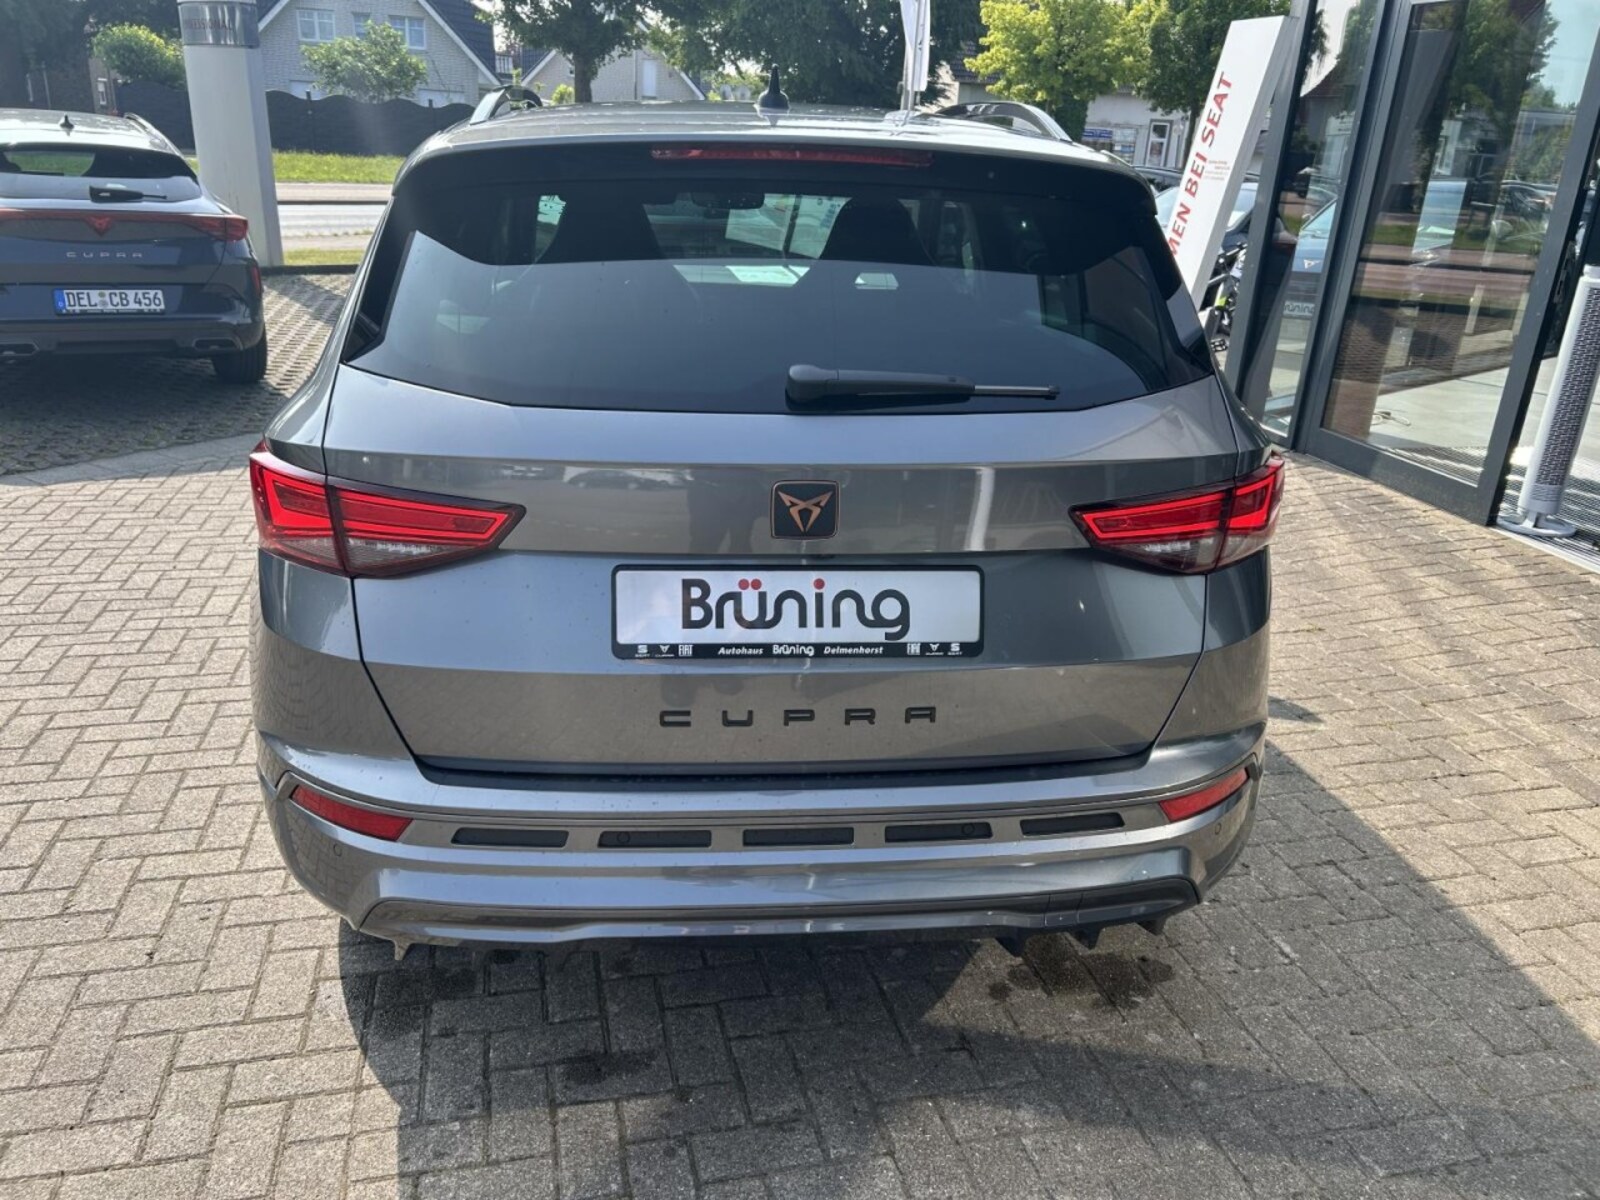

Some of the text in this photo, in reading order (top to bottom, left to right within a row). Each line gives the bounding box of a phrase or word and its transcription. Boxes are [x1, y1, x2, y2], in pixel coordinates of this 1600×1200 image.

[1185, 152, 1207, 198] BEI
[1201, 71, 1232, 147] SEAT
[66, 292, 97, 307] DEL
[109, 292, 129, 307] CB
[133, 292, 161, 307] 456
[681, 578, 910, 641] Brüning
[718, 644, 884, 657] Autohaus Brüning Delmenhorst
[659, 706, 936, 727] CUPRA
